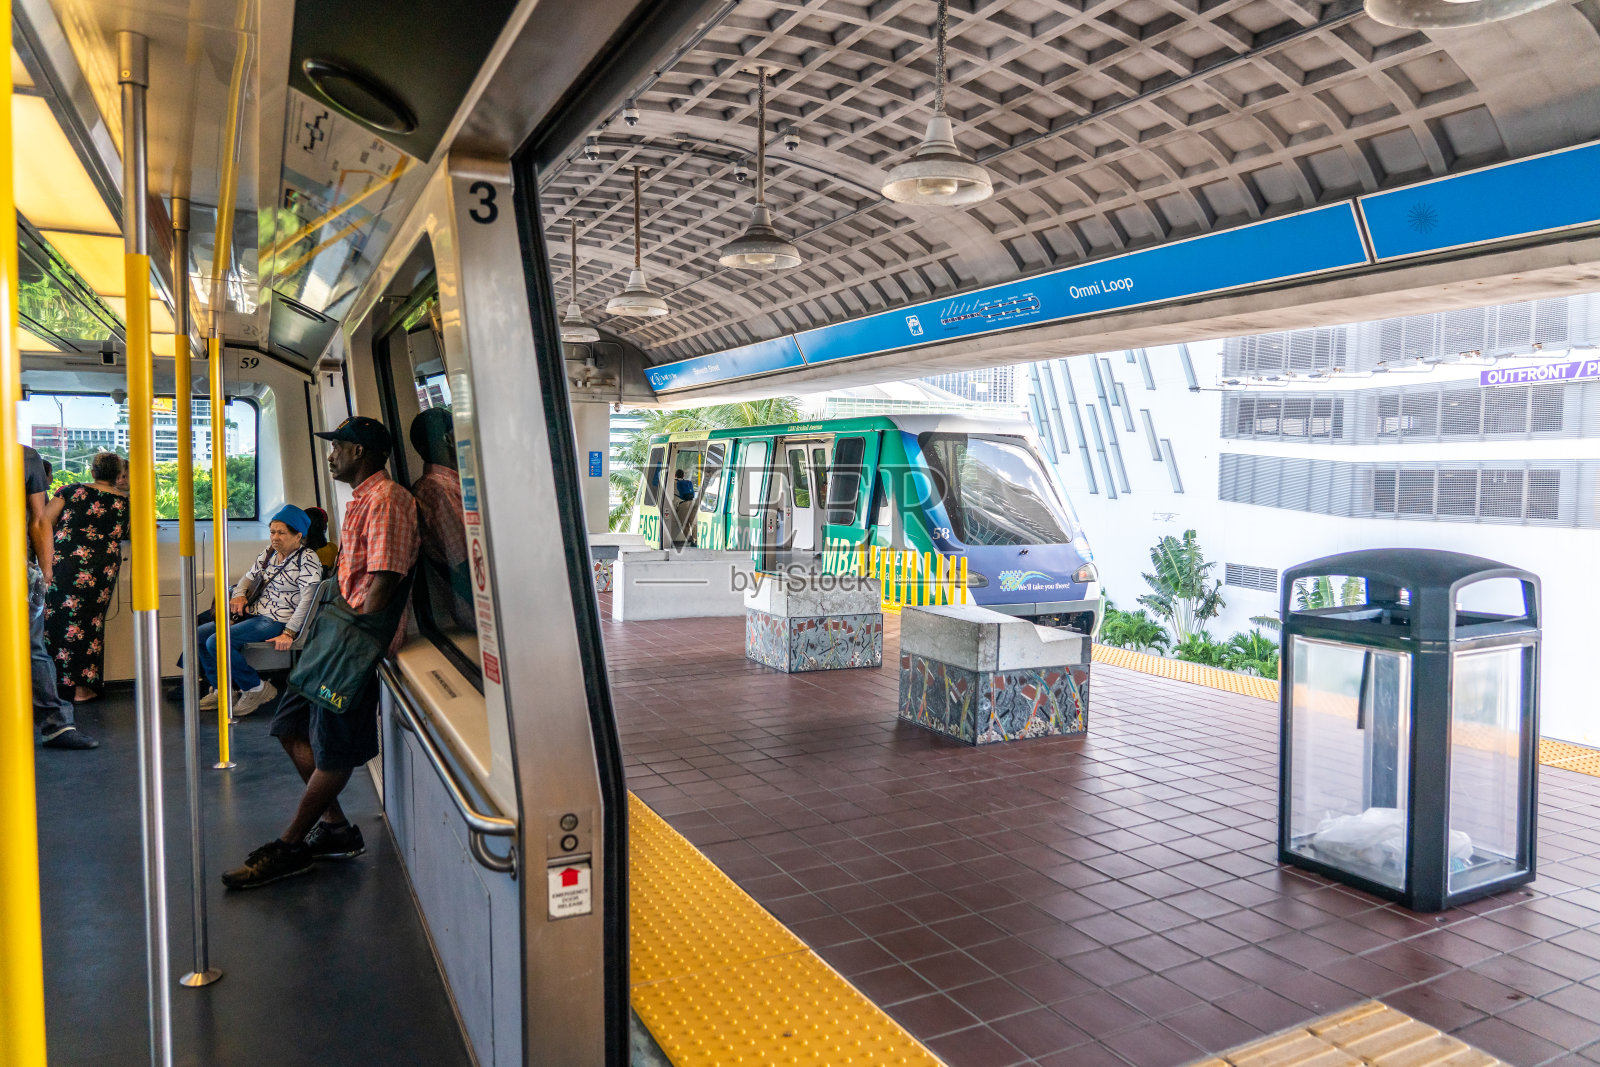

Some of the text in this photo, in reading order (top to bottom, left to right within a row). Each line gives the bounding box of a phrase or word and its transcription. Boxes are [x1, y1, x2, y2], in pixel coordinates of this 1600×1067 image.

[469, 181, 498, 225] 3
[1069, 277, 1134, 299] Omni Loop
[240, 357, 260, 369] 59
[326, 372, 334, 388] 1
[1487, 363, 1571, 384] OUTFRONT
[932, 527, 950, 540] 58
[1032, 582, 1044, 591] take
[1044, 583, 1055, 592] you
[1055, 581, 1071, 590] there!
[552, 888, 588, 899] EMERGENCY
[557, 901, 583, 909] RELEASE
